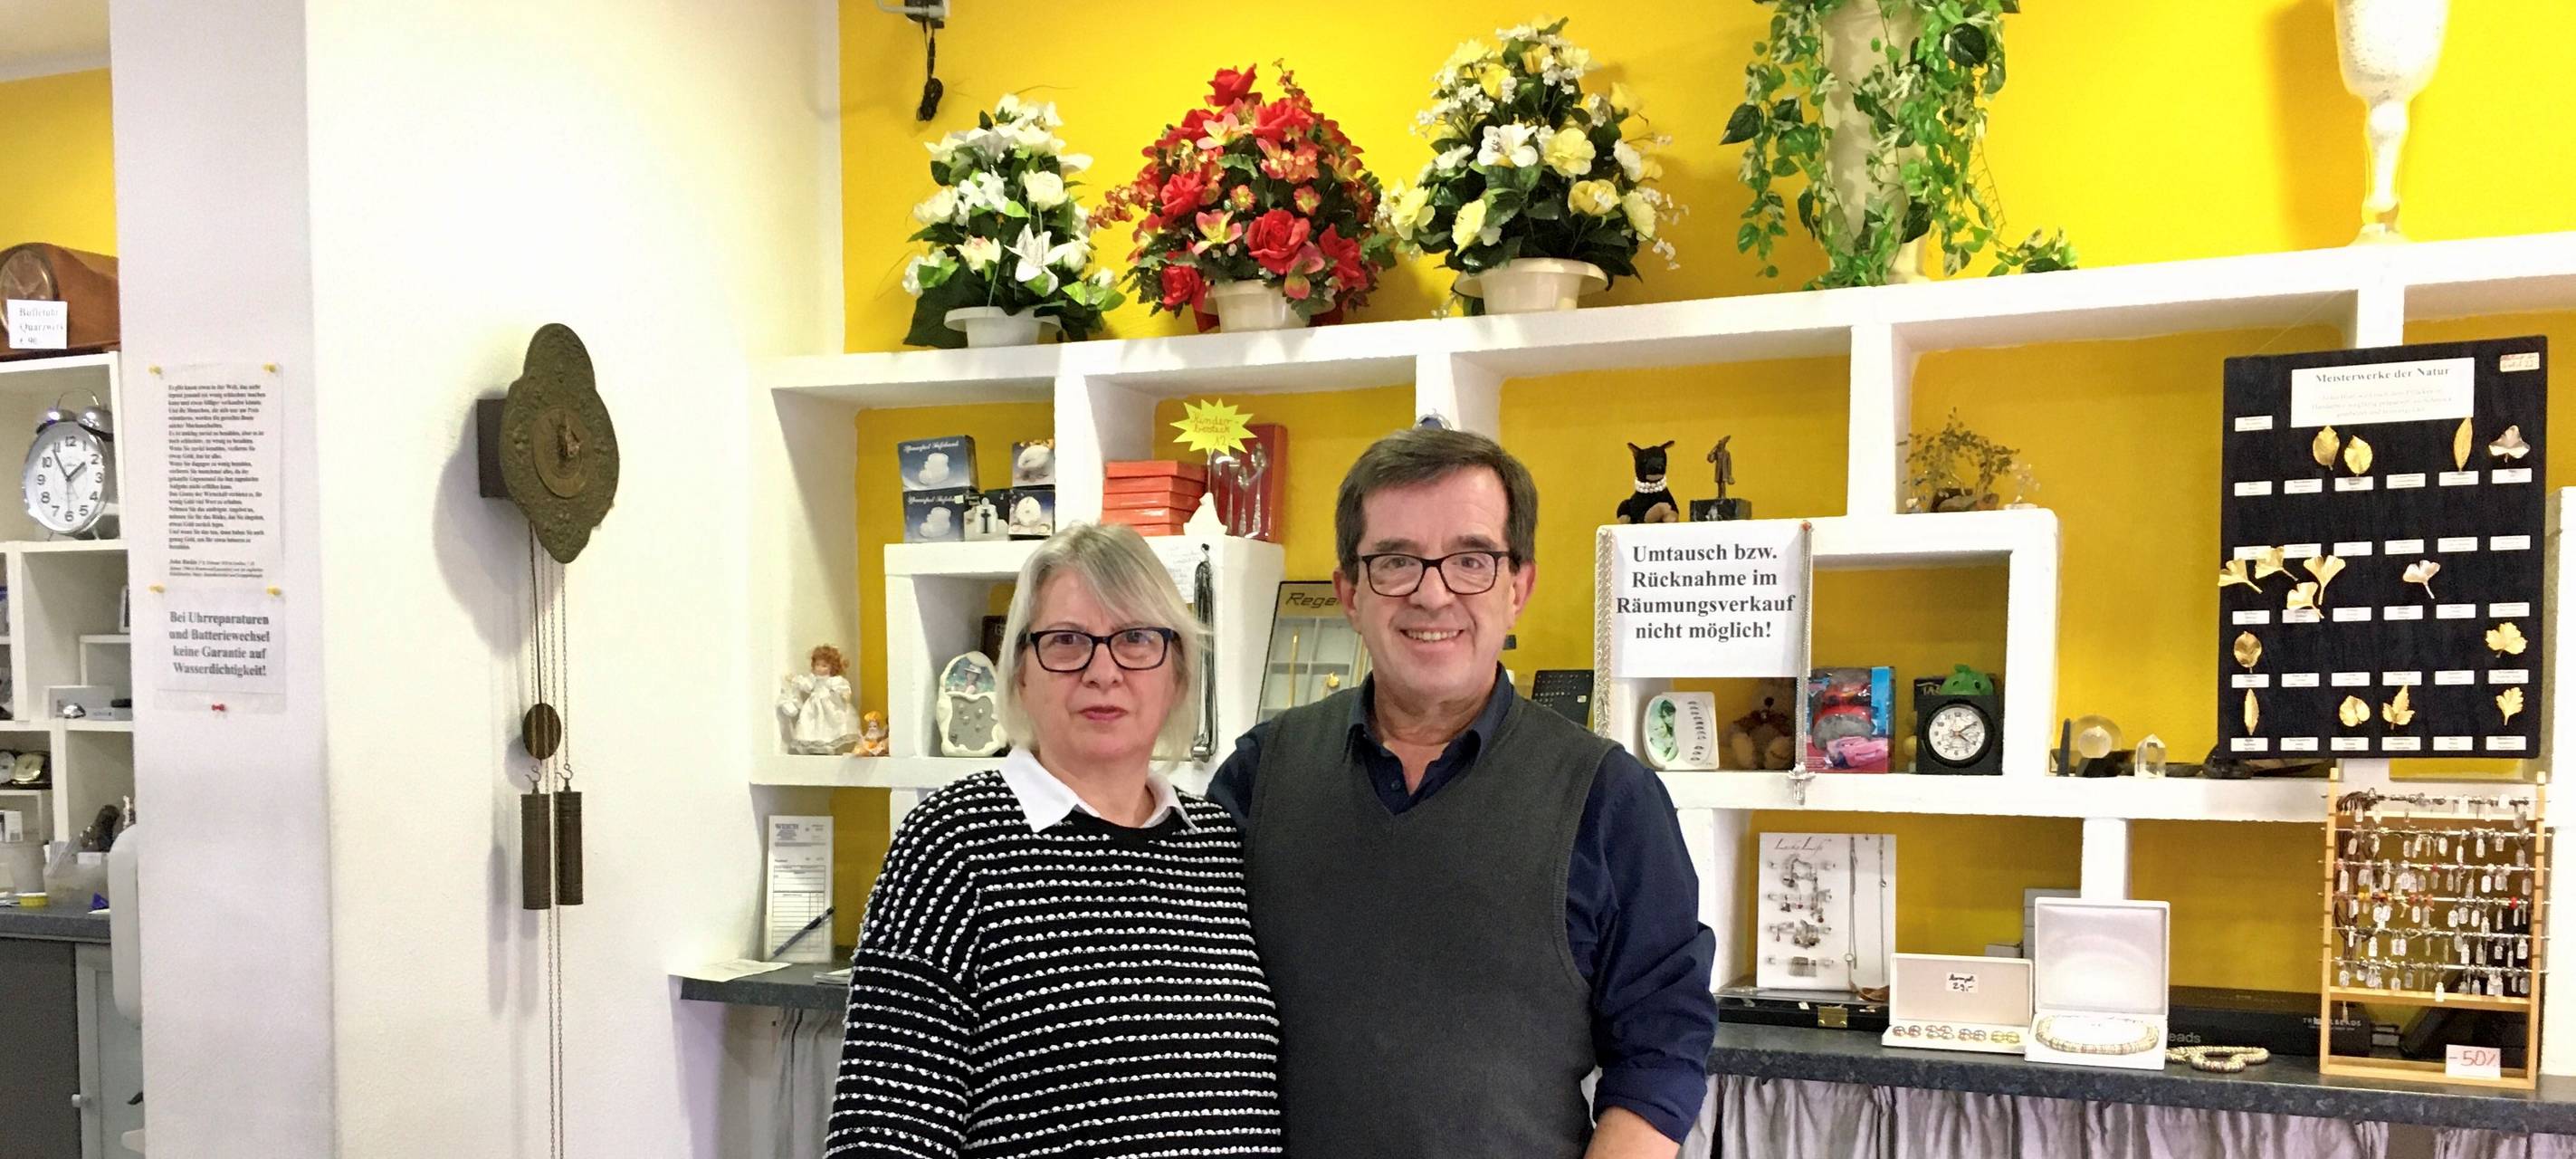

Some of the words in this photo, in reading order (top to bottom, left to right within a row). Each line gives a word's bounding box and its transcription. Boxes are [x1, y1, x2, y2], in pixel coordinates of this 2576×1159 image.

[2315, 370, 2390, 383] Meisterwerke
[2394, 369, 2412, 378] der
[2417, 367, 2450, 377] Natur
[1633, 544, 1727, 562] Umtausch
[1734, 543, 1778, 560] bzw.
[1632, 570, 1747, 588] Rücknahme
[1752, 569, 1777, 586] im
[1617, 595, 1796, 617] Räumungsverkauf
[169, 611, 186, 623] Bei
[188, 611, 269, 627] Uhrreparaturen
[168, 629, 188, 639] und
[191, 628, 271, 643] Batteriewechsel
[1636, 622, 1684, 639] nicht
[1689, 621, 1771, 643] möglich!
[173, 646, 199, 656] keine
[202, 646, 246, 659] Garantie
[249, 647, 267, 659] auf
[173, 662, 267, 678] Wasserdichtigkeit!
